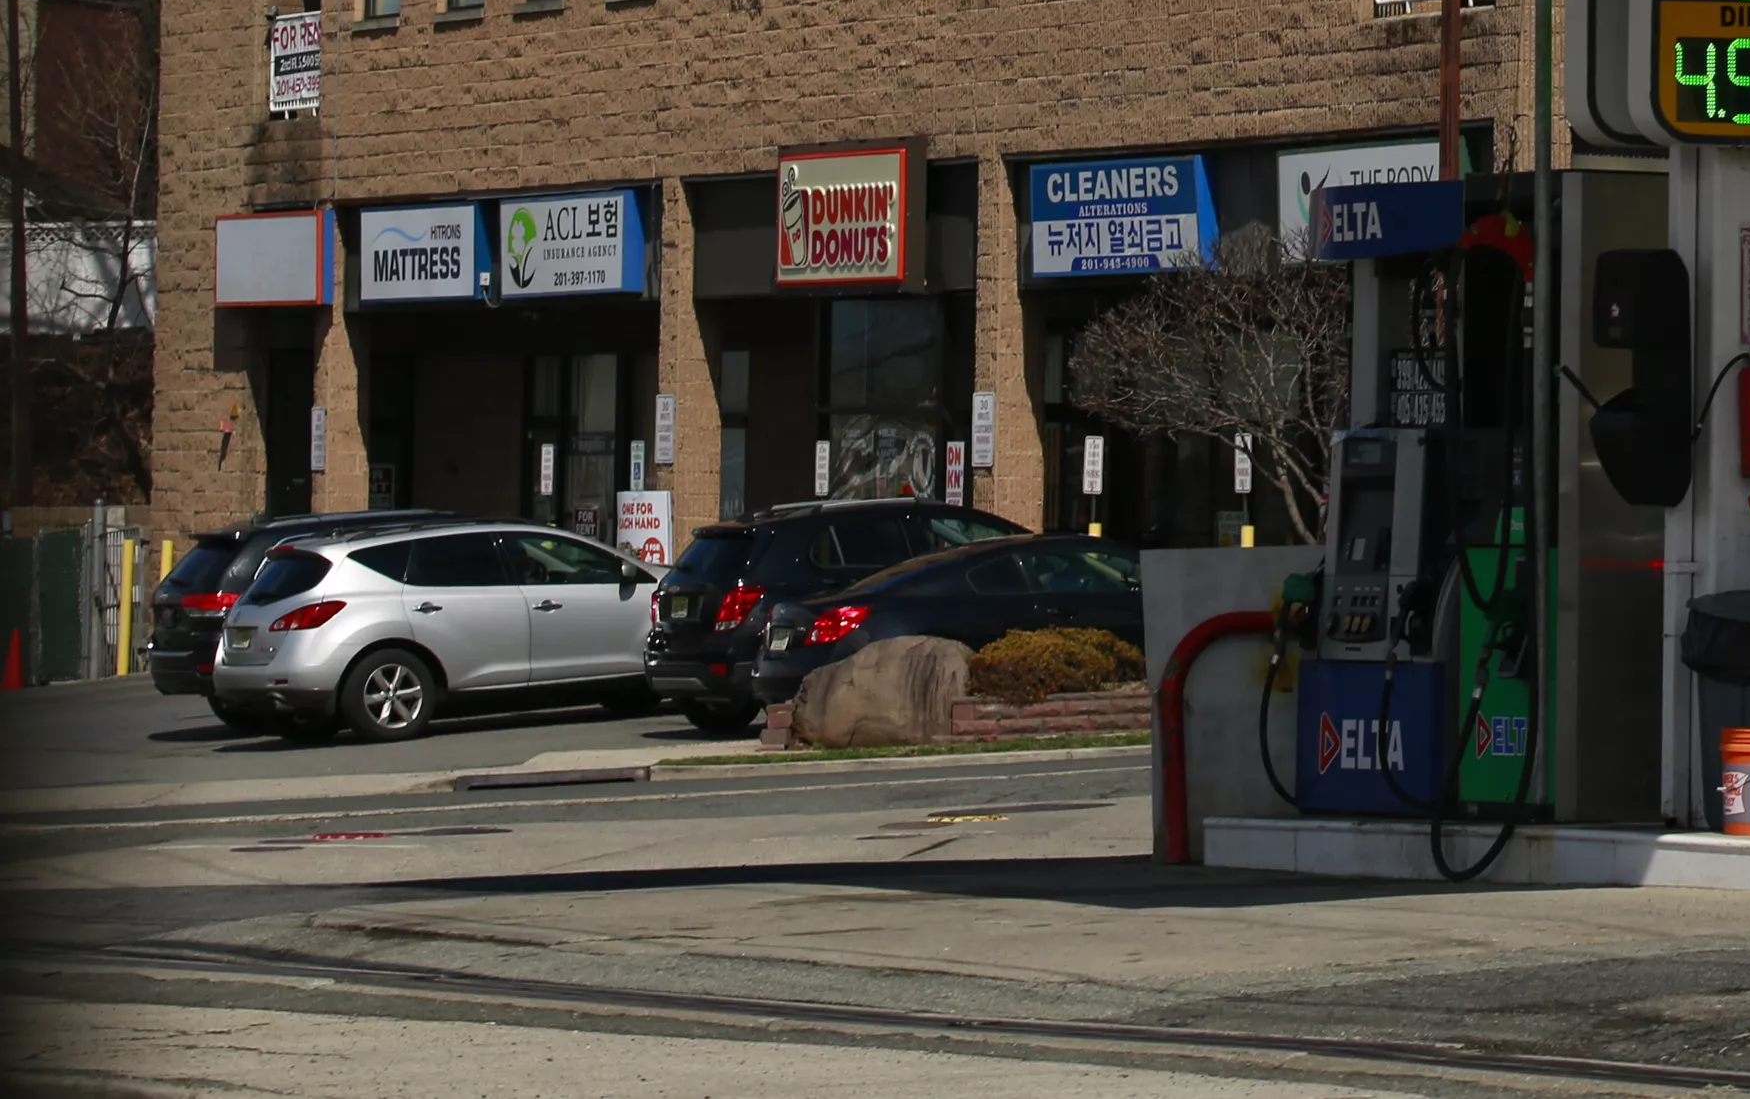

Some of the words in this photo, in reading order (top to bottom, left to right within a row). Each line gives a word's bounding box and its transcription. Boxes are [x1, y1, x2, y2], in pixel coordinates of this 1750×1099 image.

[272, 25, 297, 50] FOR
[300, 22, 321, 47] REN
[1046, 165, 1179, 203] CLEANERS
[812, 184, 893, 225] DUNKIN'
[1078, 202, 1148, 217] ALTERATIONS
[543, 206, 582, 242] ACL
[586, 200, 618, 238] 보험
[811, 225, 888, 265] DONUTS
[1048, 222, 1100, 256] 뉴저지
[1108, 218, 1183, 253] 열쇠금고
[543, 246, 585, 260] INSURANCE
[587, 244, 617, 258] AGENCY
[374, 246, 461, 282] MATTRESS
[554, 269, 606, 286] 201-397-1170
[947, 446, 961, 466] DN
[577, 510, 594, 523] FOR
[622, 503, 635, 515] ONE
[636, 503, 653, 515] FOR
[575, 523, 596, 536] RENT
[635, 517, 660, 530] HAND
